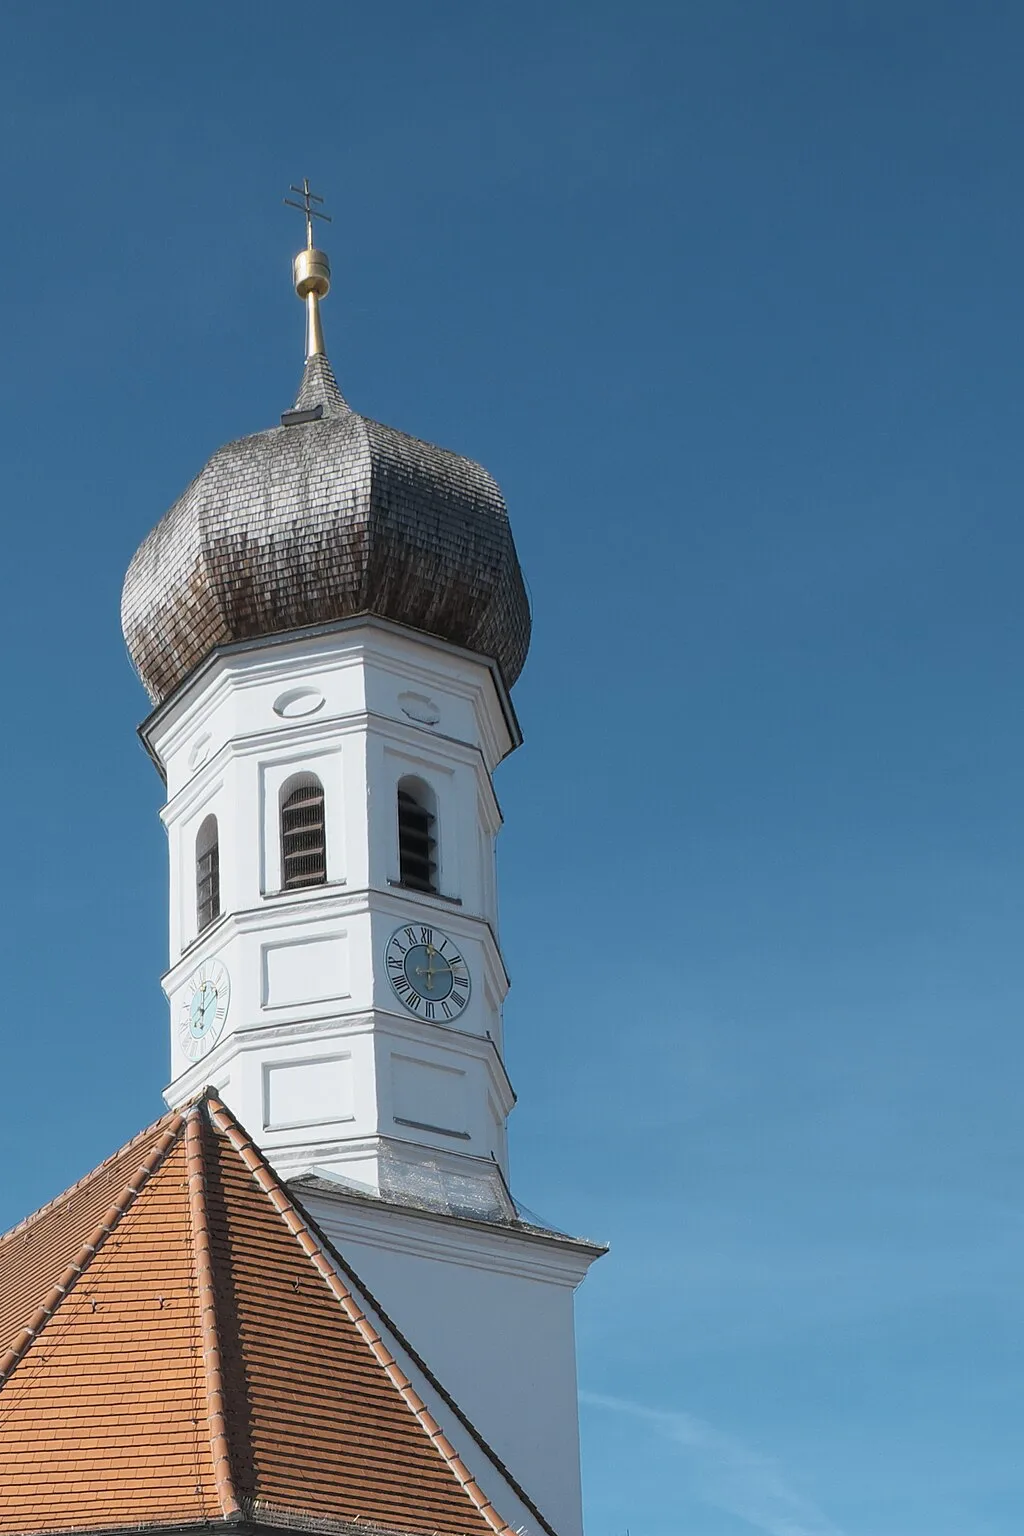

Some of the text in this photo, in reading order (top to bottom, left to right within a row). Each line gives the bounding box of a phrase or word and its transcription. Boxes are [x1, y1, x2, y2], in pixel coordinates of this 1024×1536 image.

[404, 928, 418, 946] XI
[421, 927, 432, 944] XII
[392, 938, 407, 954] X
[440, 940, 447, 952] I
[388, 956, 403, 970] IX
[448, 955, 462, 966] II
[392, 975, 410, 995] VIII
[454, 976, 468, 988] III
[406, 991, 421, 1010] VII
[450, 990, 466, 1008] IIII
[425, 1001, 435, 1019] VI
[441, 1001, 453, 1018] V
